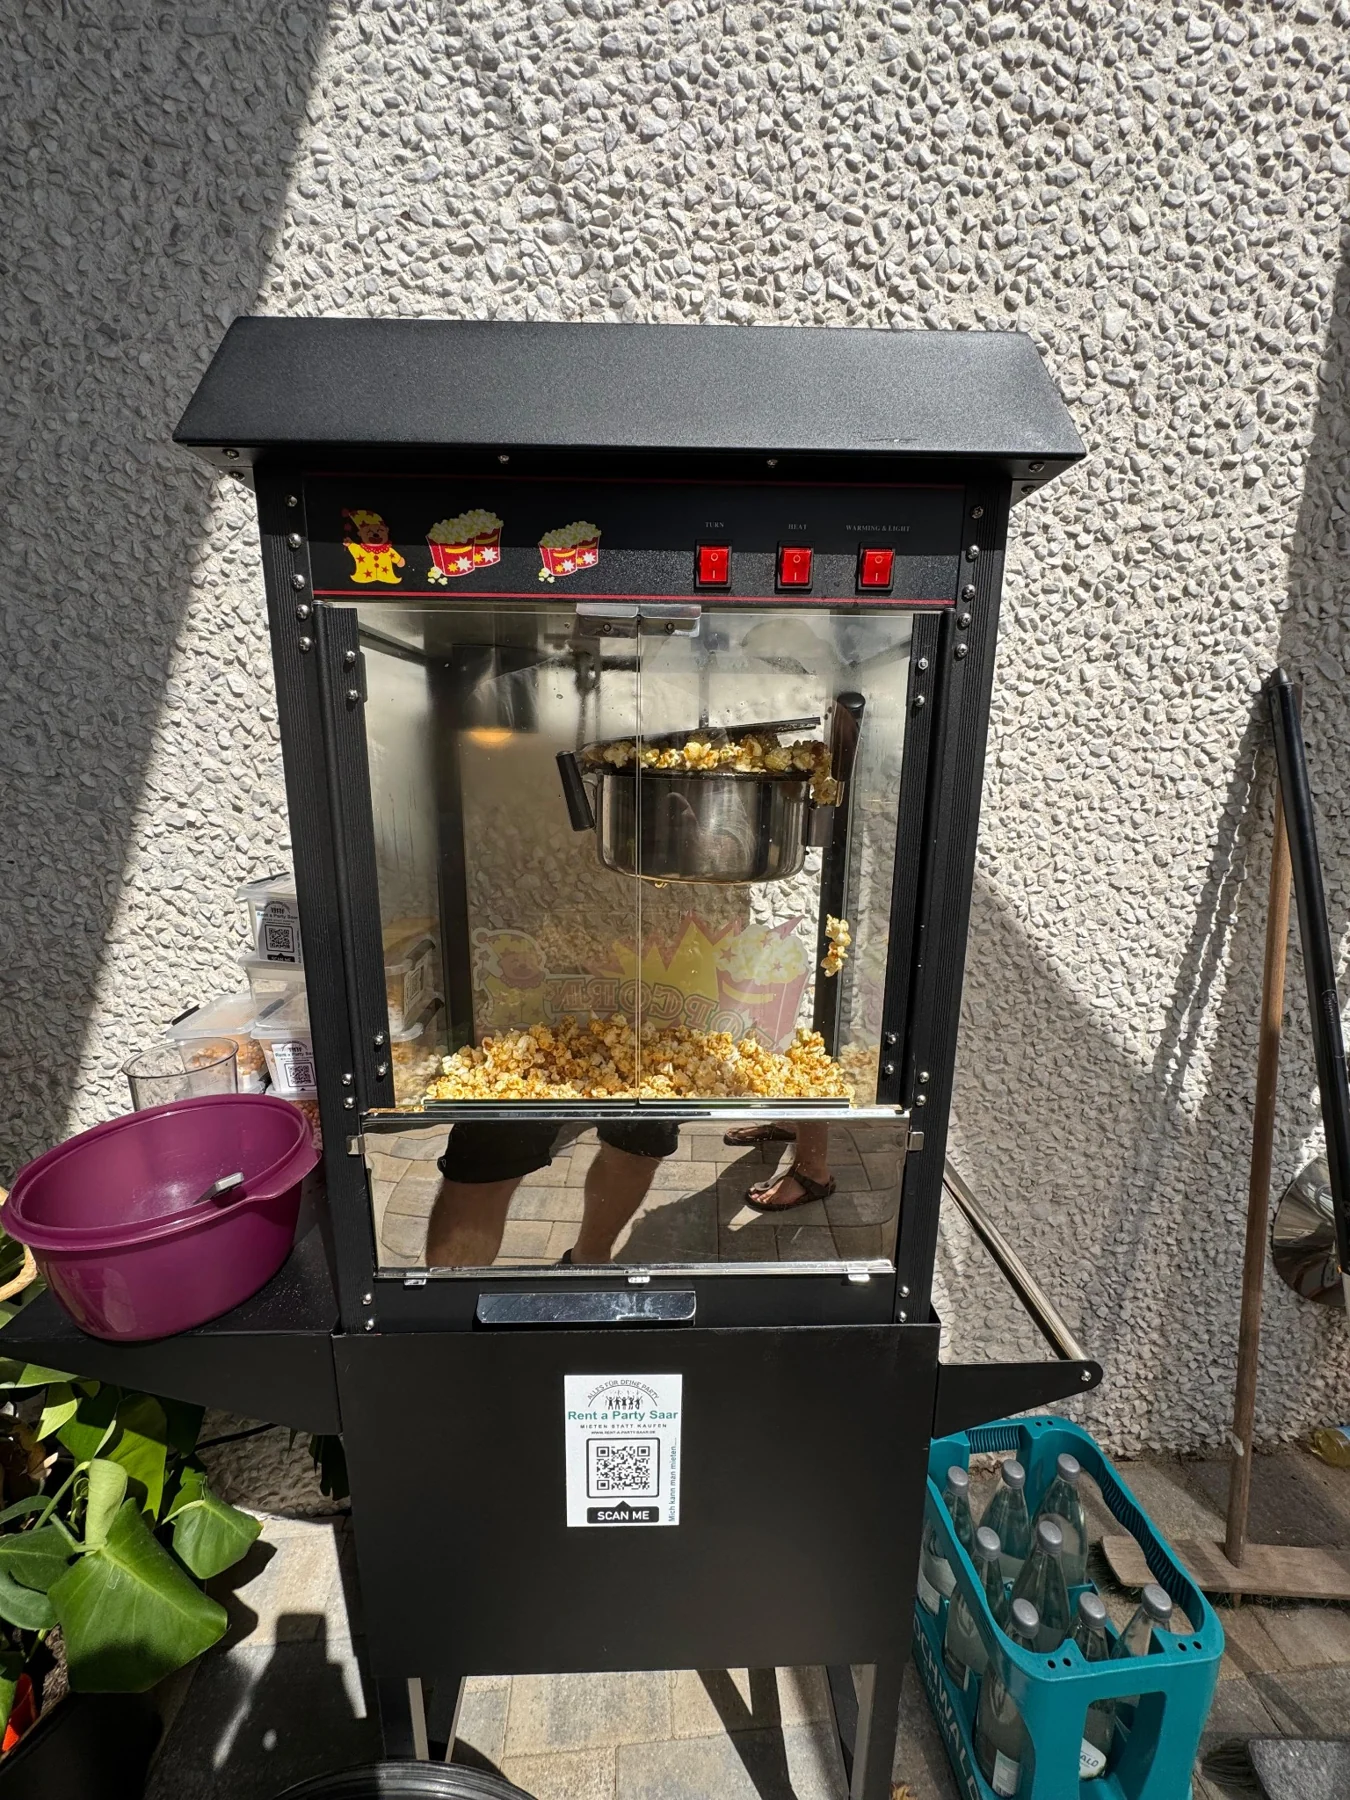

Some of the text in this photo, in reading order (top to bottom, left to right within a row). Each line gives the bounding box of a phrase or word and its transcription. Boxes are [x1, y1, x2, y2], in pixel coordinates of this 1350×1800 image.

[705, 521, 725, 529] TURN
[788, 523, 808, 531] HEAT
[845, 524, 881, 532] WARMING
[888, 525, 911, 533] LIGHT
[587, 1379, 660, 1400] ALLES FÜR DEINE PARTY
[568, 1411, 598, 1420] Rent
[612, 1410, 646, 1421] Party
[649, 1410, 679, 1420] Saar
[668, 1487, 676, 1504] kann
[597, 1510, 650, 1520] SCAN ME
[668, 1505, 676, 1522] Mich
[913, 1613, 979, 1800] OCHWALD
